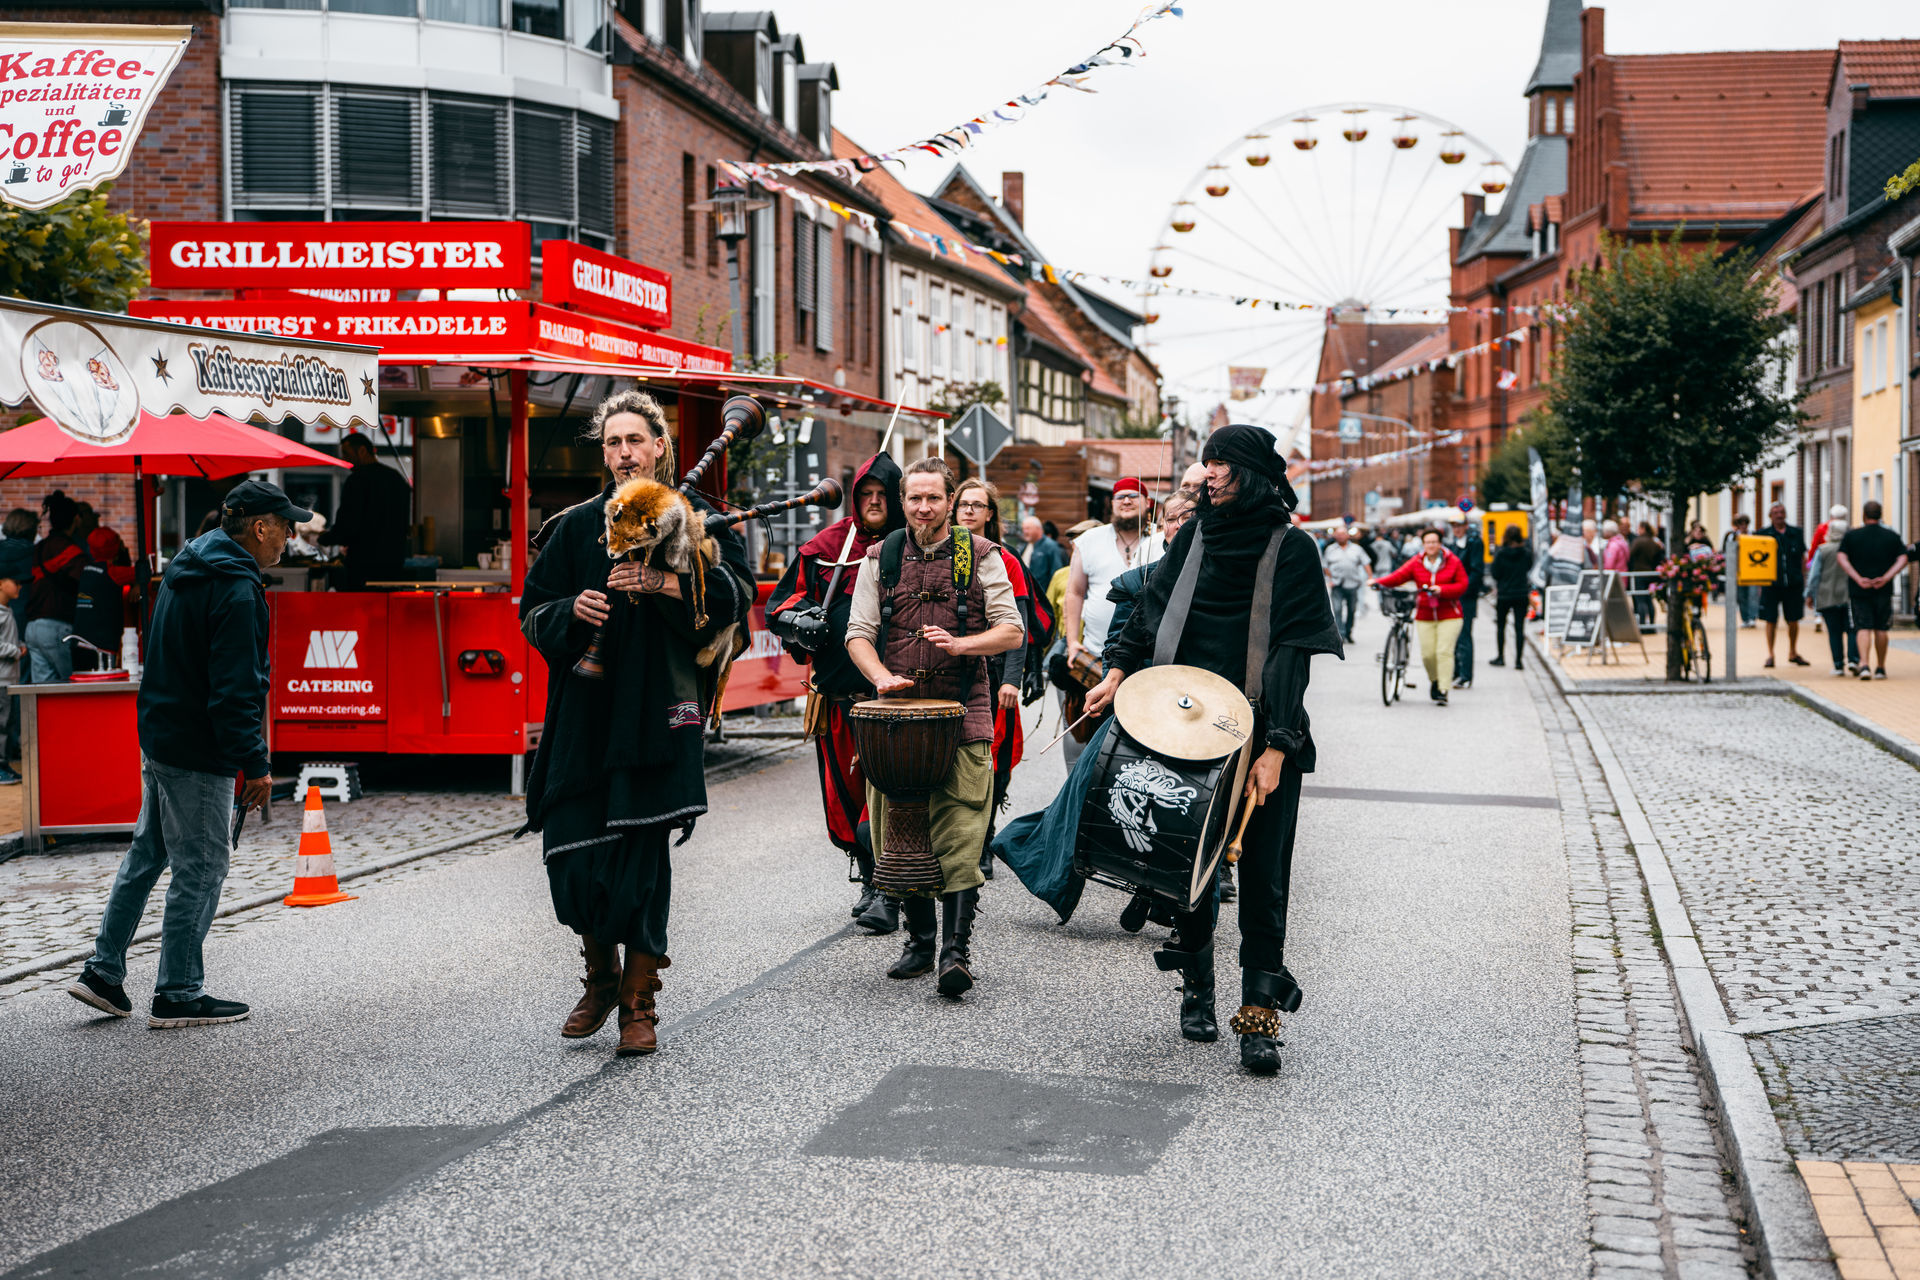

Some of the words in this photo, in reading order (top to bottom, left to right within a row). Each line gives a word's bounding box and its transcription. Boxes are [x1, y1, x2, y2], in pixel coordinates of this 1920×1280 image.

[0, 49, 156, 83] Kaffee-
[0, 83, 142, 108] pezialitäten
[45, 105, 76, 116] und
[36, 165, 53, 183] to
[59, 151, 95, 188] go!
[170, 241, 504, 268] GRILLMEISTER
[573, 258, 668, 313] GRILLMEISTER
[152, 316, 317, 335] ATWURST
[337, 316, 507, 335] FRIKADELLE
[539, 320, 585, 347] KRAKAUER
[588, 332, 639, 358] CURRYWURST
[642, 344, 683, 368] BRATWURST
[189, 346, 350, 403] Kaffeespezialitäten
[287, 679, 374, 693] CATERING
[281, 704, 381, 716] www.mz-catering.de
